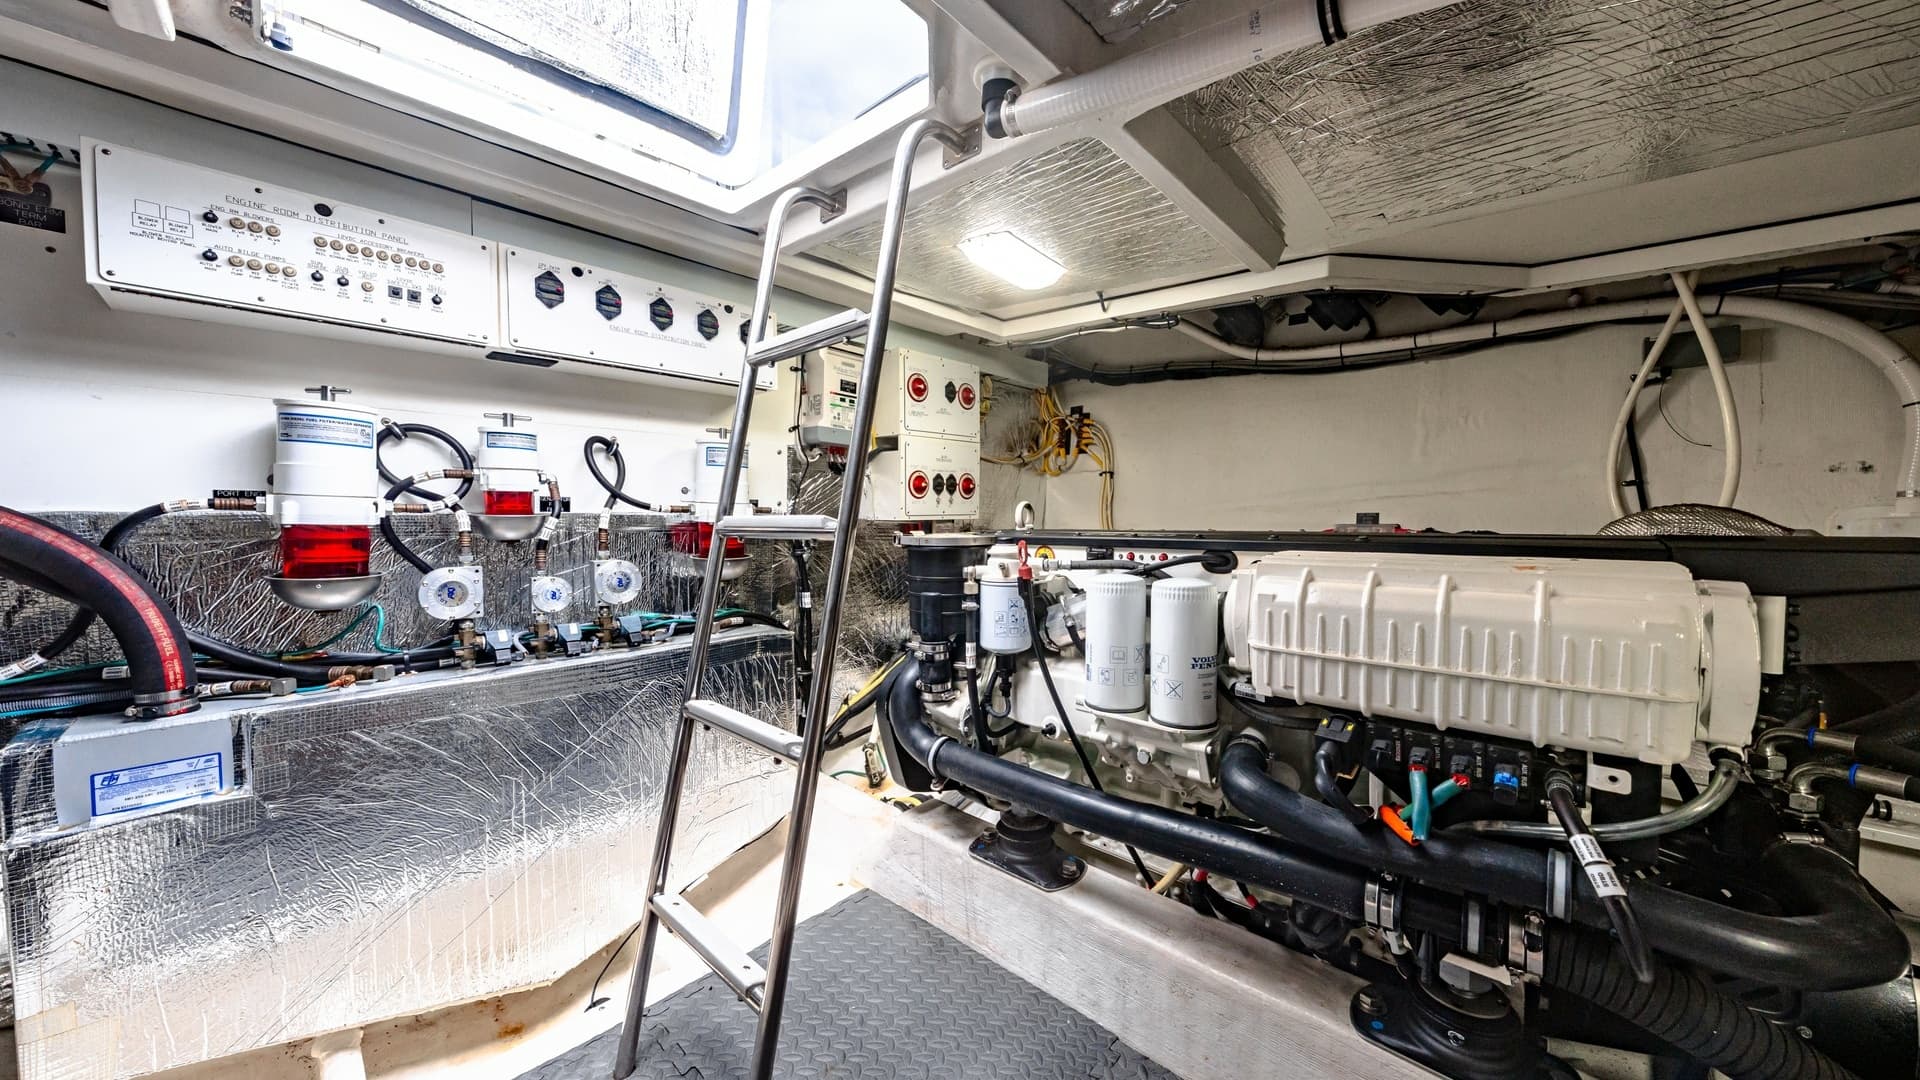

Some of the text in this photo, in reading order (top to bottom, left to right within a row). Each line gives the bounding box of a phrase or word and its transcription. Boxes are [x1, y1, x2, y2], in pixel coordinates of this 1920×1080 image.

[15, 209, 47, 222] TERM
[210, 204, 225, 213] ENG
[243, 212, 275, 223] BLOWERS
[225, 195, 409, 246] ENGINE ROOM DISTRIBUTION PANEL
[214, 244, 287, 263] AUTO BILGE PUMPS
[1521, 763, 1529, 776] AUX
[1598, 871, 1610, 888] STBD
